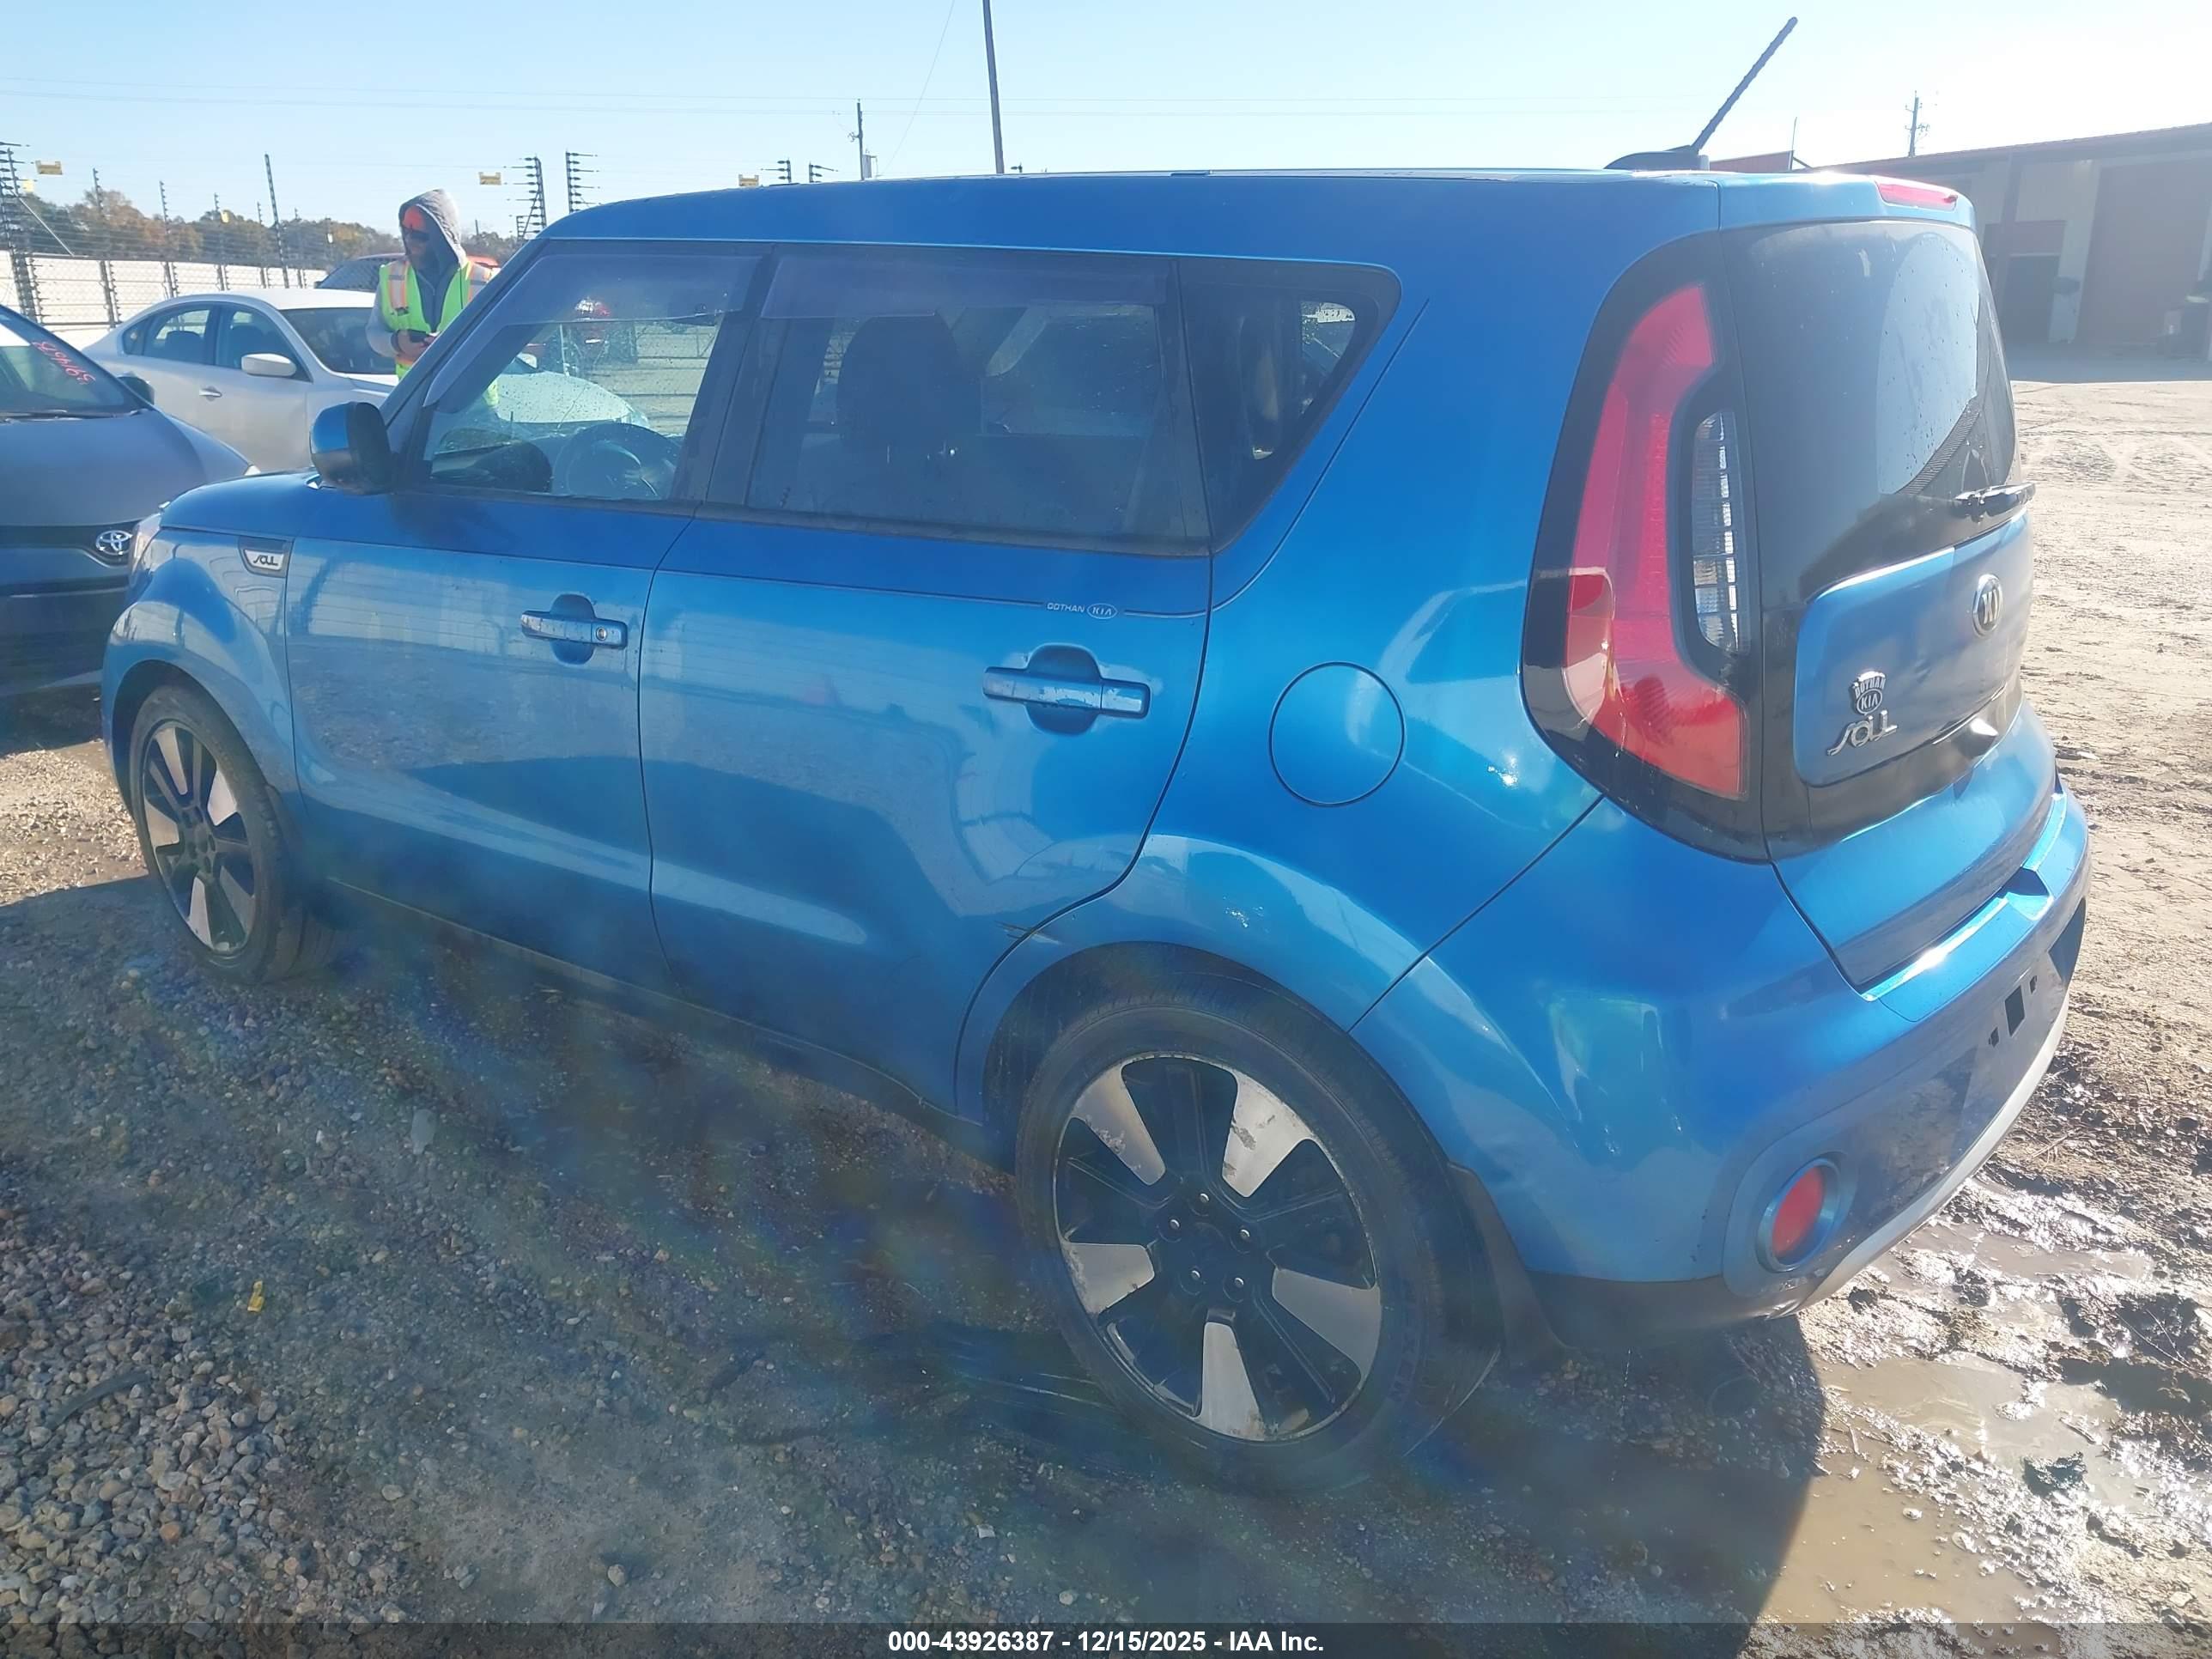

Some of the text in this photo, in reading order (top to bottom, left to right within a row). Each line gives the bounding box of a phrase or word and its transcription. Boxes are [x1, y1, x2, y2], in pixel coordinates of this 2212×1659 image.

[1091, 606, 1113, 616] KIA
[1859, 692, 1879, 711] KIA
[1826, 710, 1898, 757] SOUL
